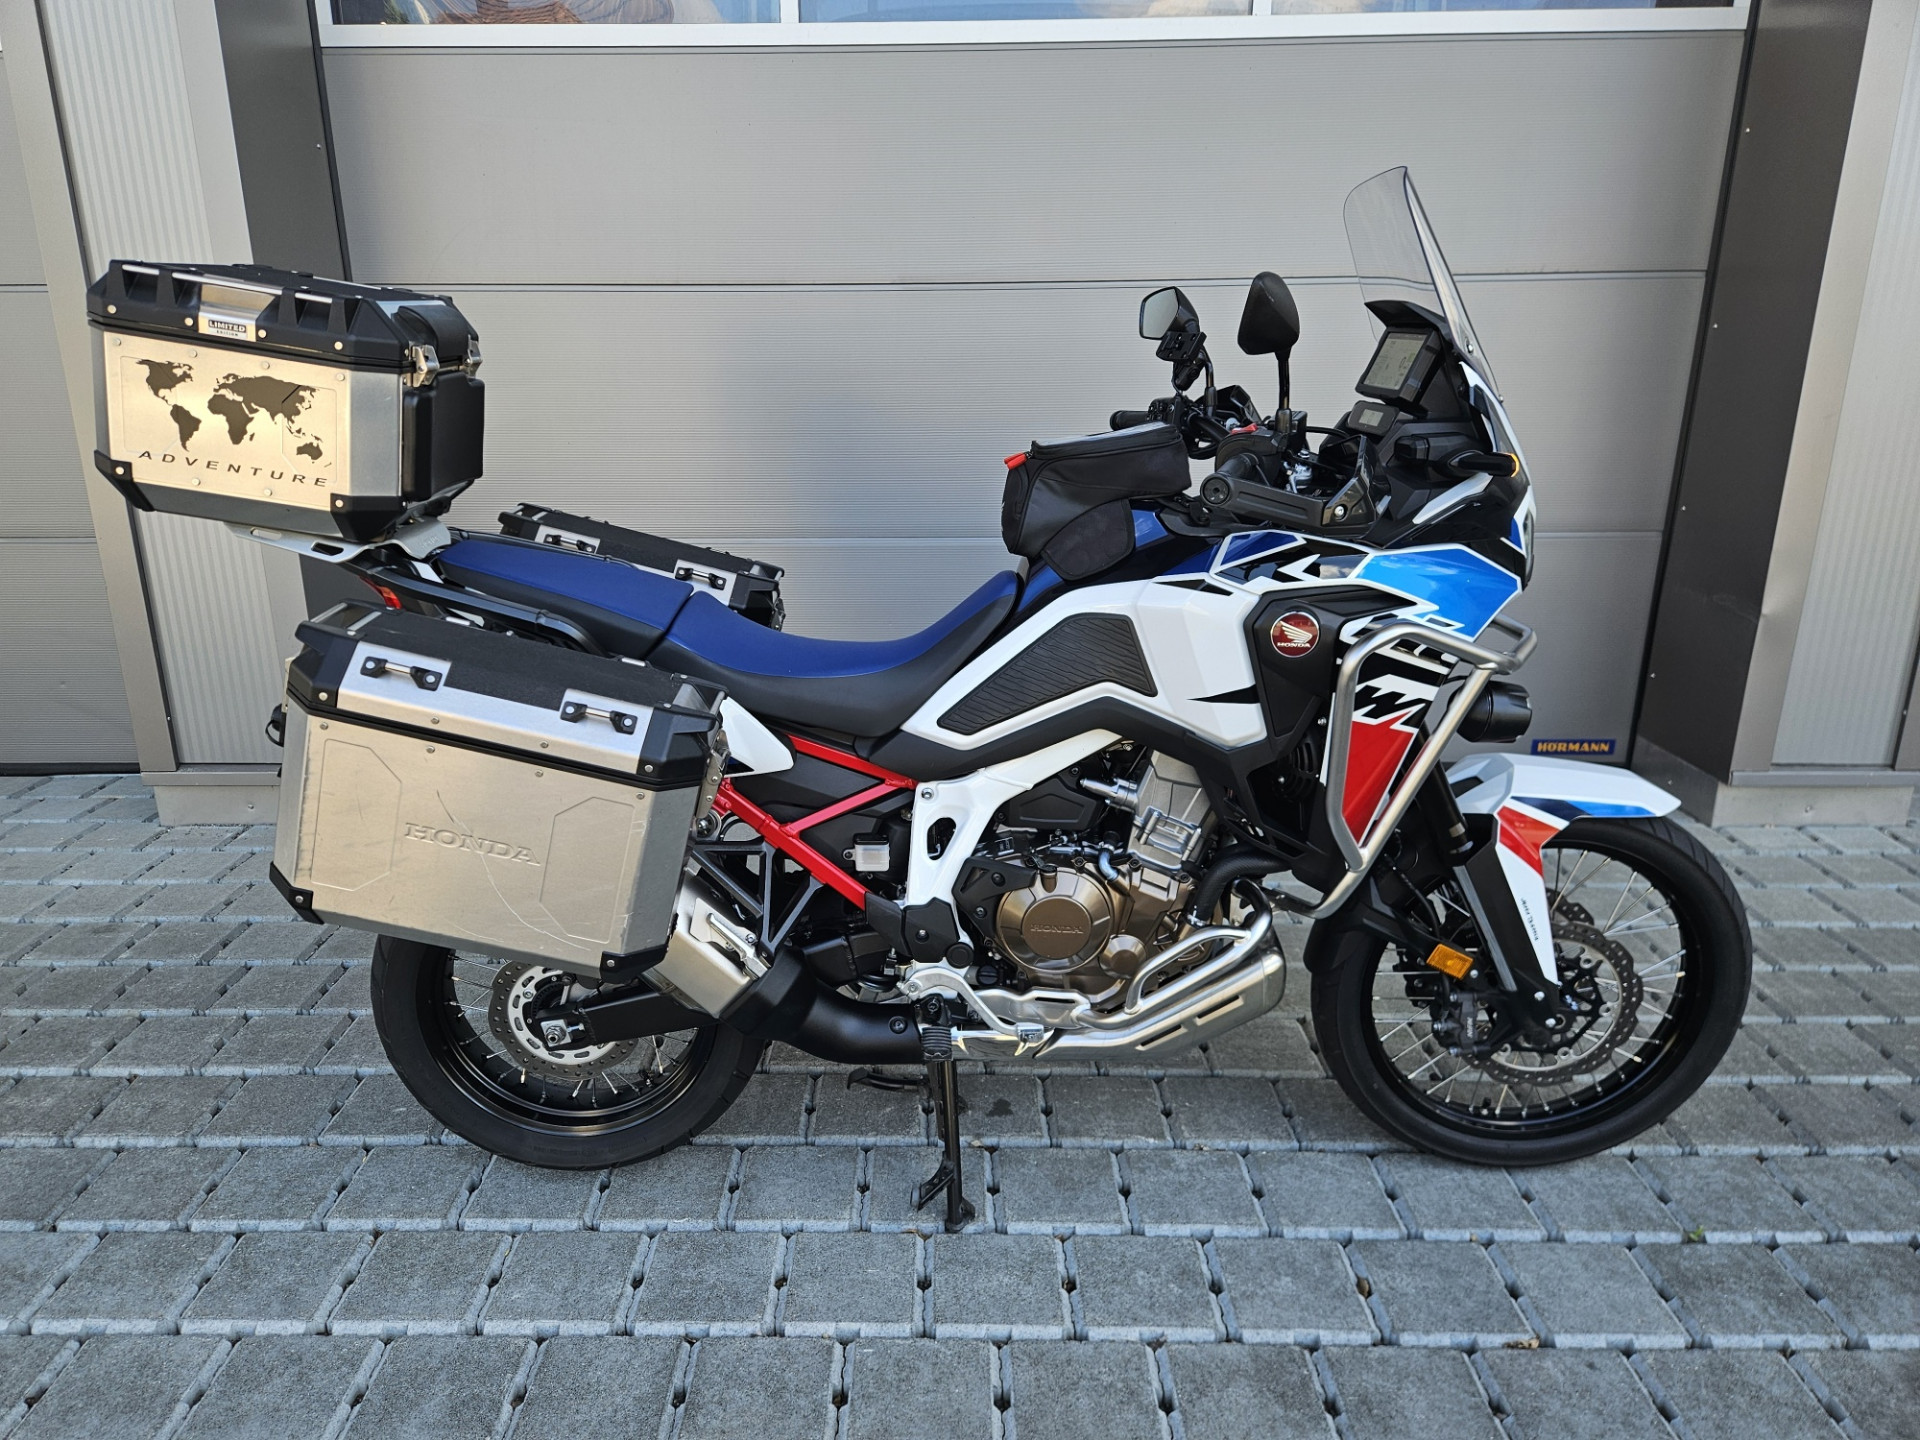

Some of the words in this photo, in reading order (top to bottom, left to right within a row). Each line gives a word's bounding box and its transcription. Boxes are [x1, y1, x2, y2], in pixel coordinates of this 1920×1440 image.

[209, 320, 246, 332] LIMITED
[138, 450, 328, 488] ADVENTURE
[404, 822, 542, 867] HONDA
